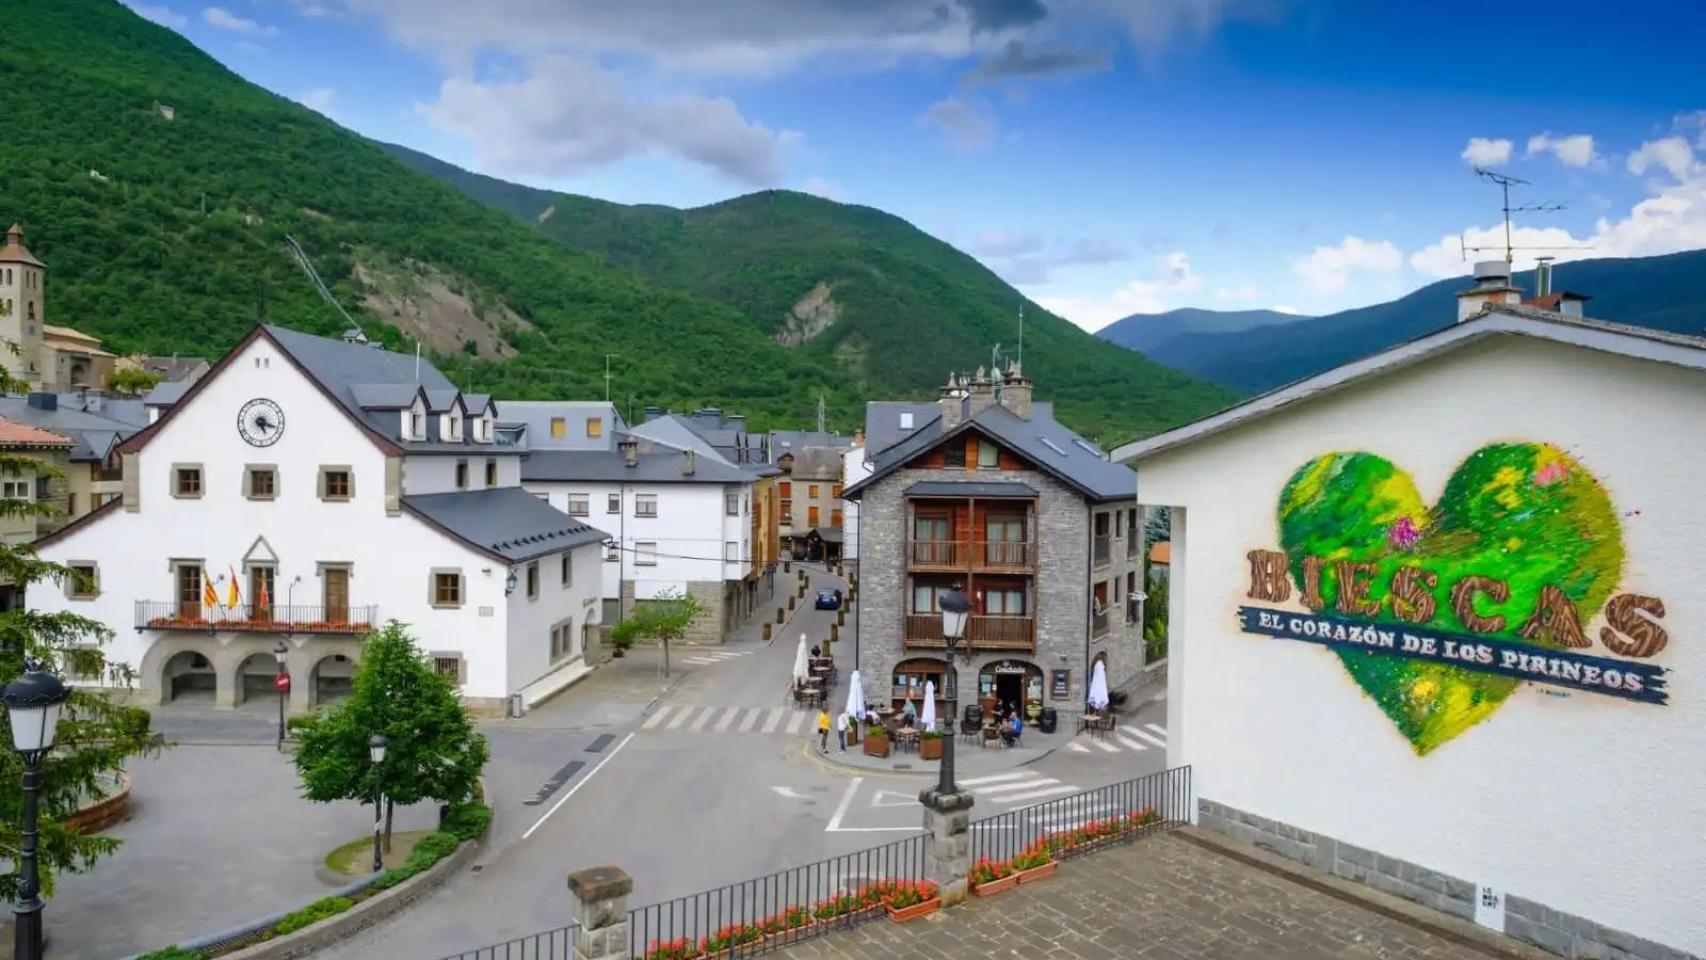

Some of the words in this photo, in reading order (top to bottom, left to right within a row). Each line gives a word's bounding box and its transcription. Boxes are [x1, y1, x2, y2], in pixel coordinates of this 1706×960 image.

[1246, 549, 1670, 658] BIESCAS
[1258, 611, 1284, 630] EL
[1289, 618, 1396, 648] CORAZÓN
[1401, 633, 1438, 656] DE
[1442, 640, 1494, 665] LOS
[1499, 650, 1645, 693] PIRINEOS
